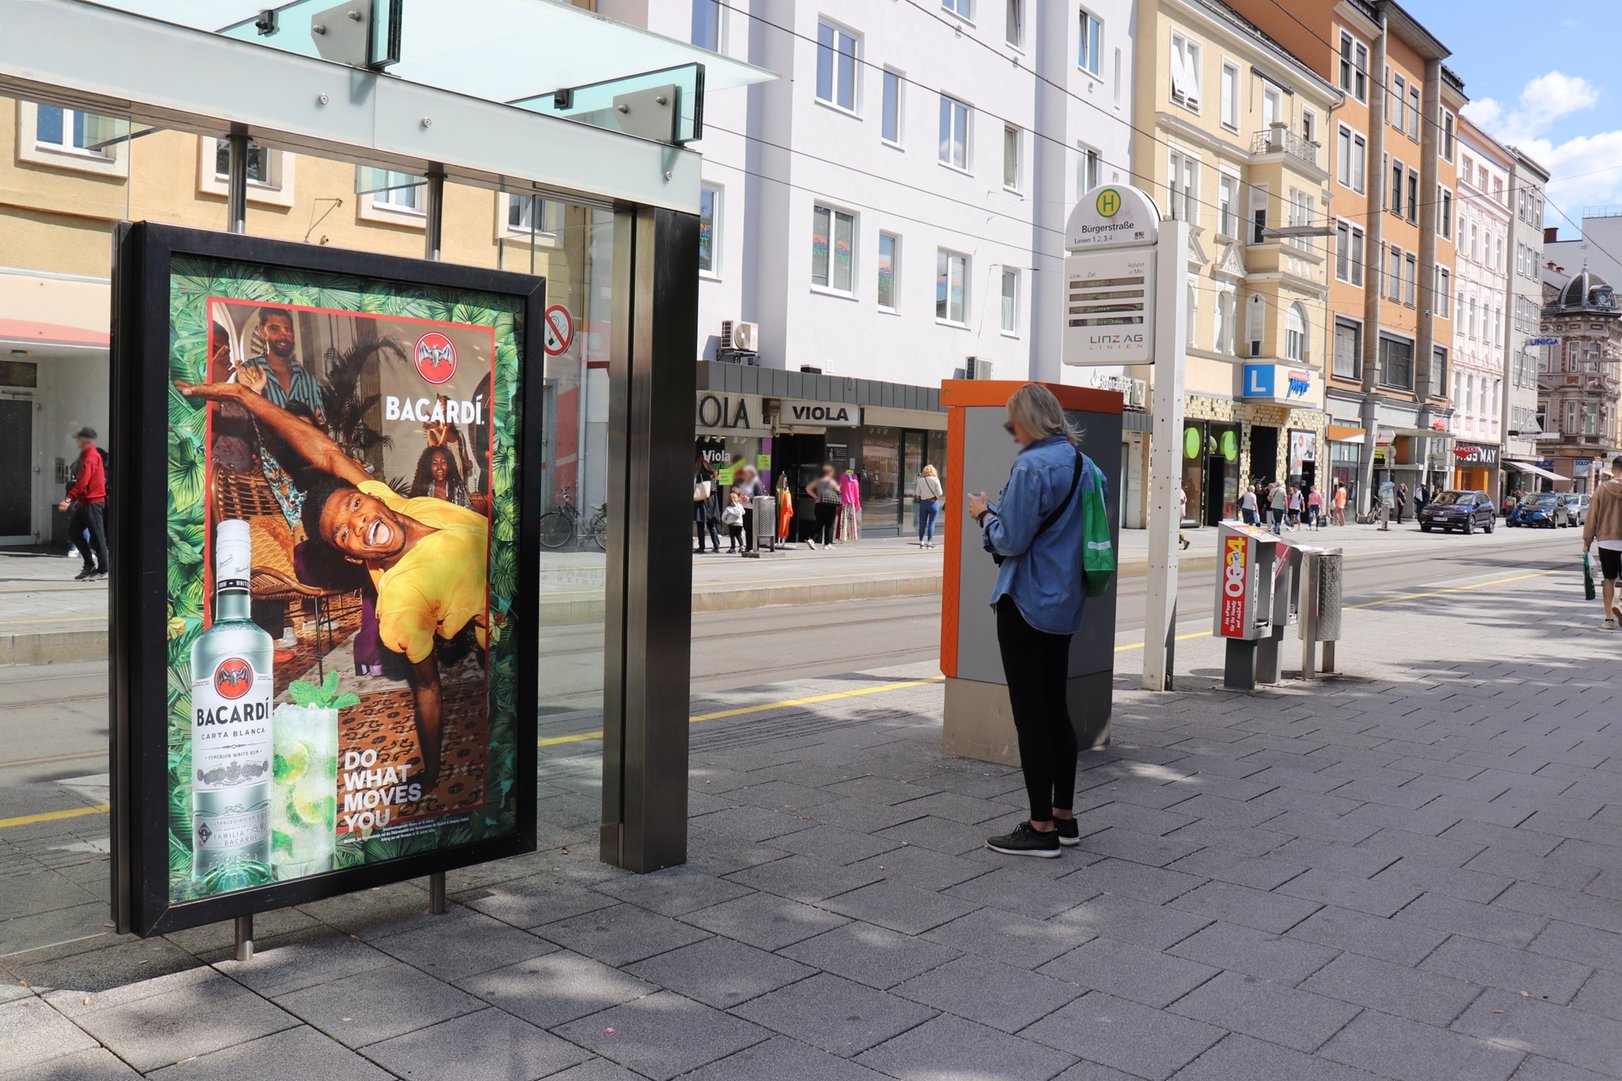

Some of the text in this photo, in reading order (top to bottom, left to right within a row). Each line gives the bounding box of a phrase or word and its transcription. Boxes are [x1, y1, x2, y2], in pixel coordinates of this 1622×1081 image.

[1103, 194, 1114, 212] H
[1081, 221, 1134, 234] Bürgerstraße
[1089, 343, 1143, 351] LINIEN
[1090, 334, 1143, 344] LINZ AG
[385, 393, 484, 426] BACARDÍ
[792, 406, 849, 421] VIOLA
[702, 449, 731, 463] Viola
[1480, 448, 1497, 463] MAY
[196, 696, 269, 727] BACARDÍ
[201, 727, 266, 740] CARTA BLANCA
[344, 749, 377, 770] DO
[343, 764, 412, 791] WHAT
[343, 783, 422, 812] MOVES
[343, 808, 391, 833] YOU
